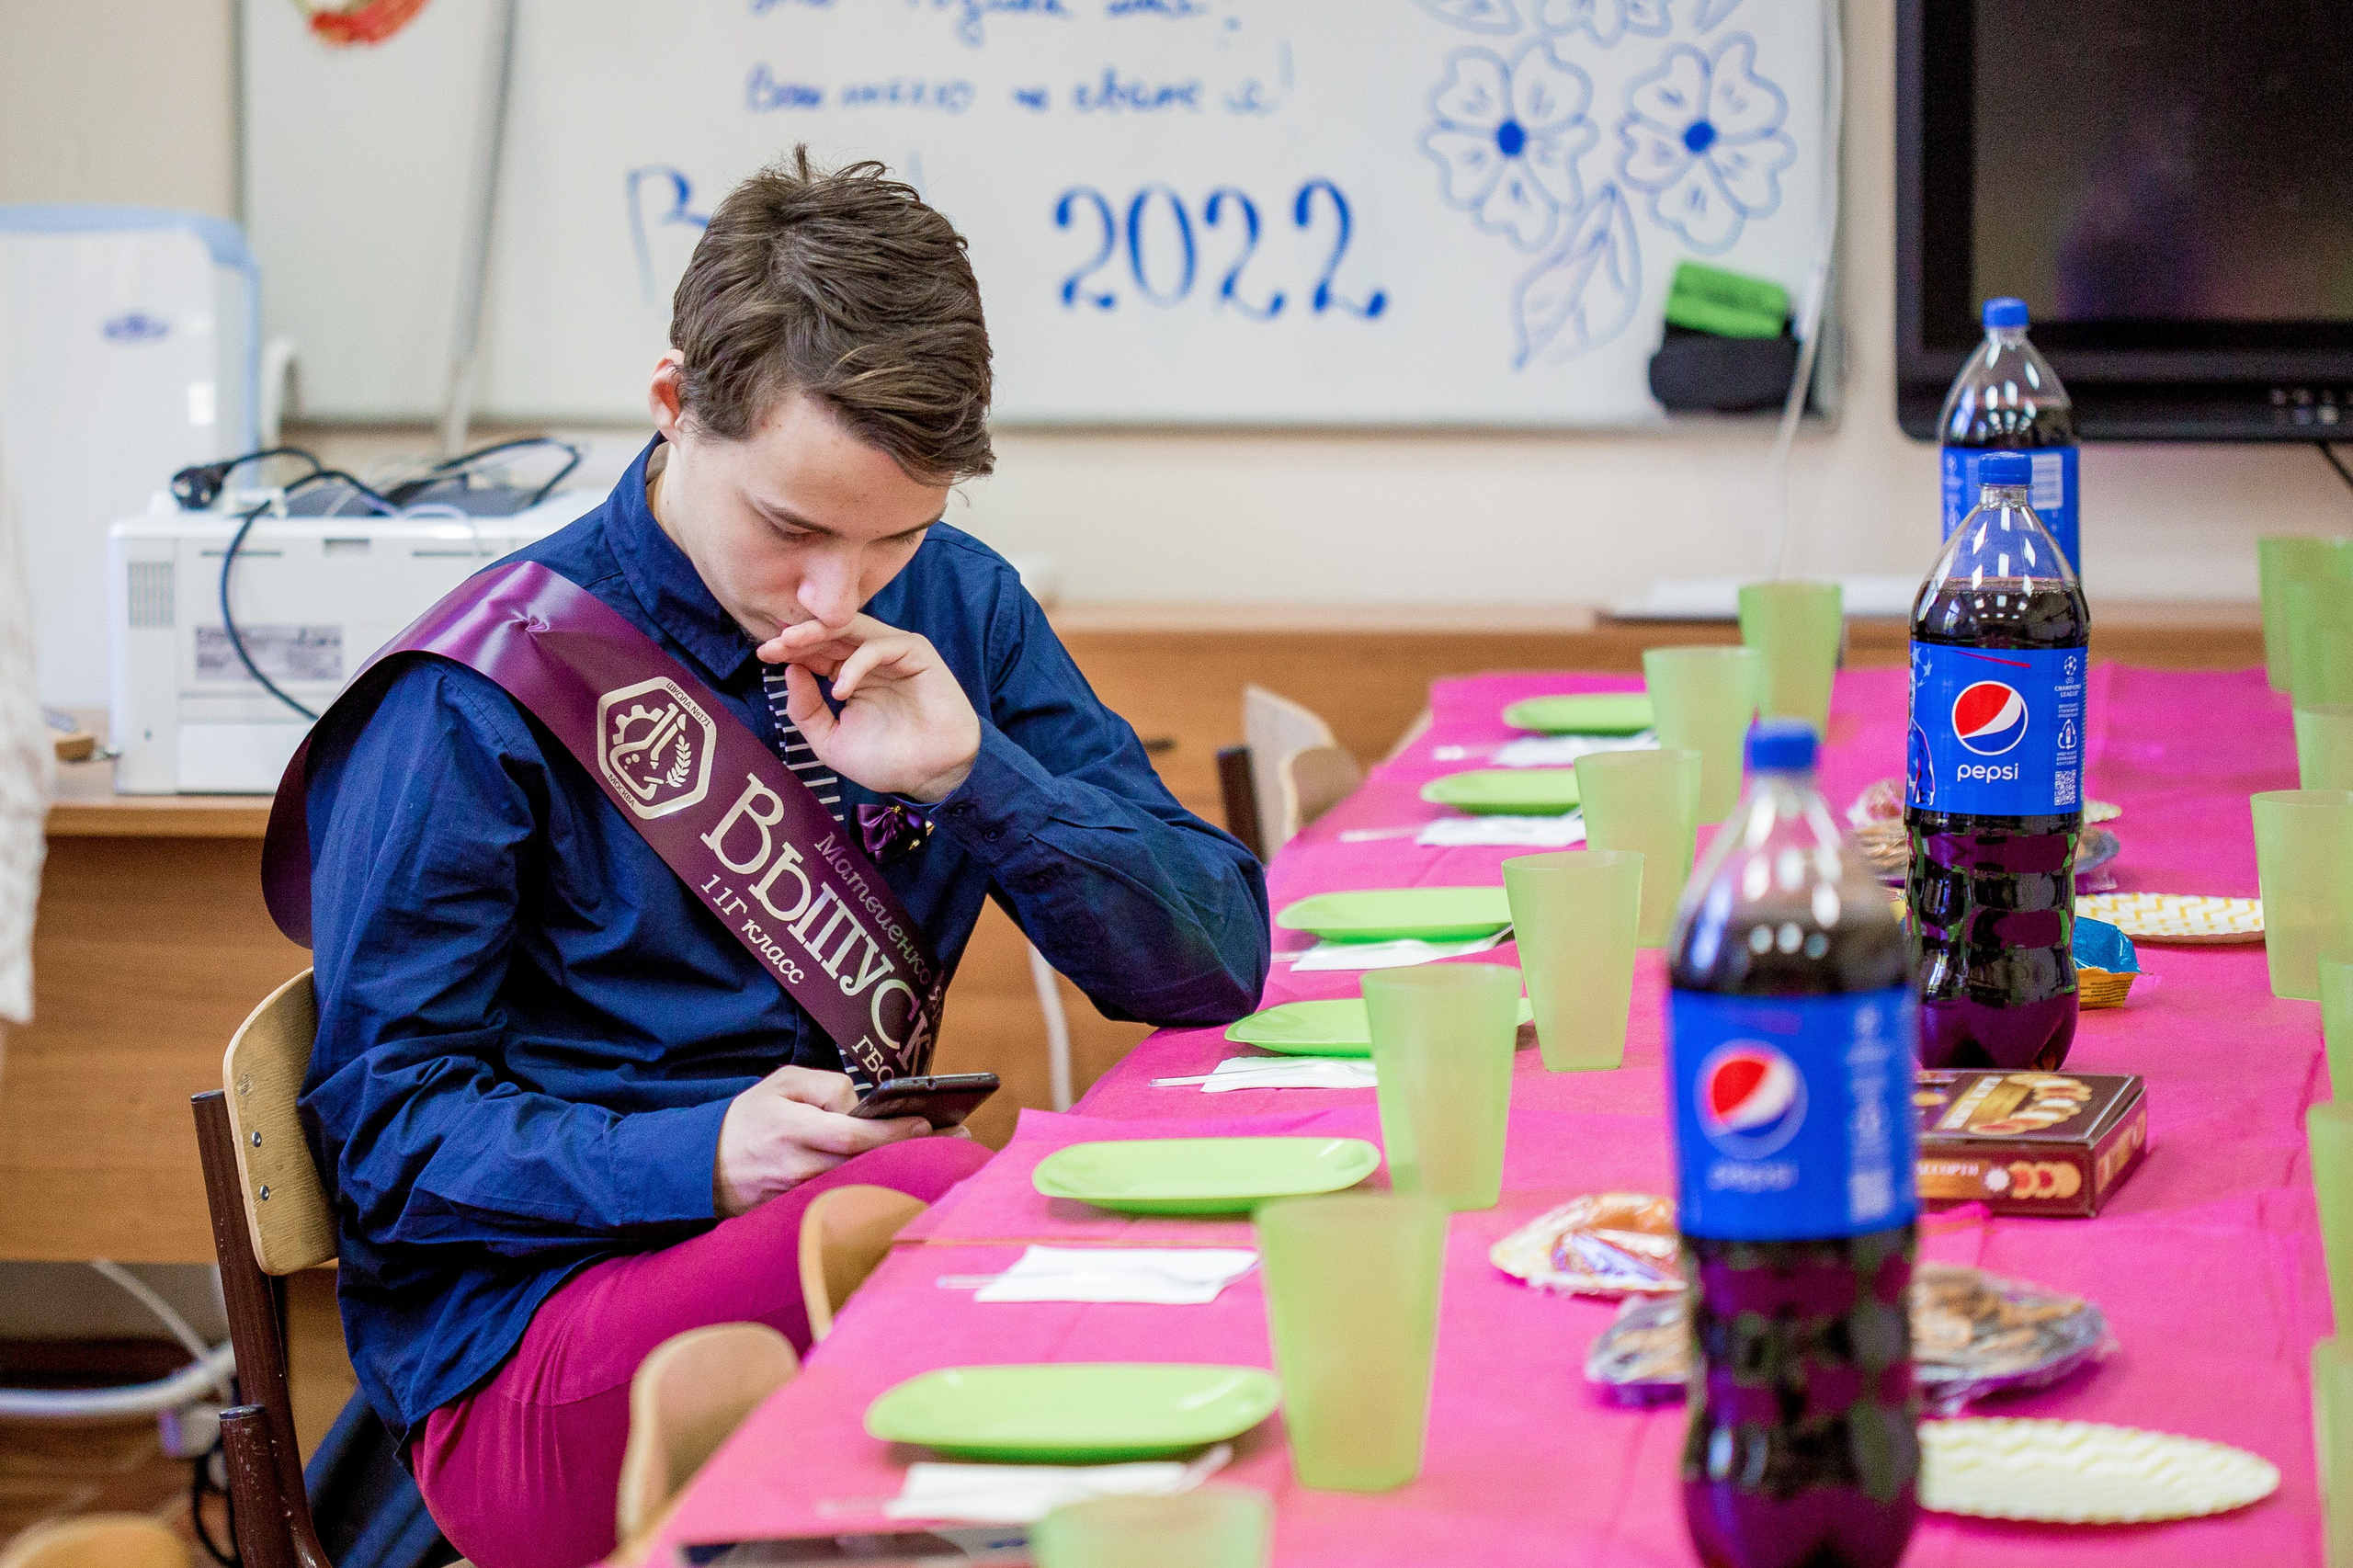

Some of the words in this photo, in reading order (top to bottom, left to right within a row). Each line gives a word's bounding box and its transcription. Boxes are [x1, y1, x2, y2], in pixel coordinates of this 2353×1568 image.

[1054, 175, 1392, 322] 2022
[665, 681, 692, 710] ШКОЛА
[690, 706, 711, 728] №171
[608, 773, 635, 807] МОСКВА
[1957, 763, 2019, 784] pepsi
[700, 873, 748, 916] 11Г
[741, 918, 805, 984] класс
[814, 831, 932, 985] Матвиенко
